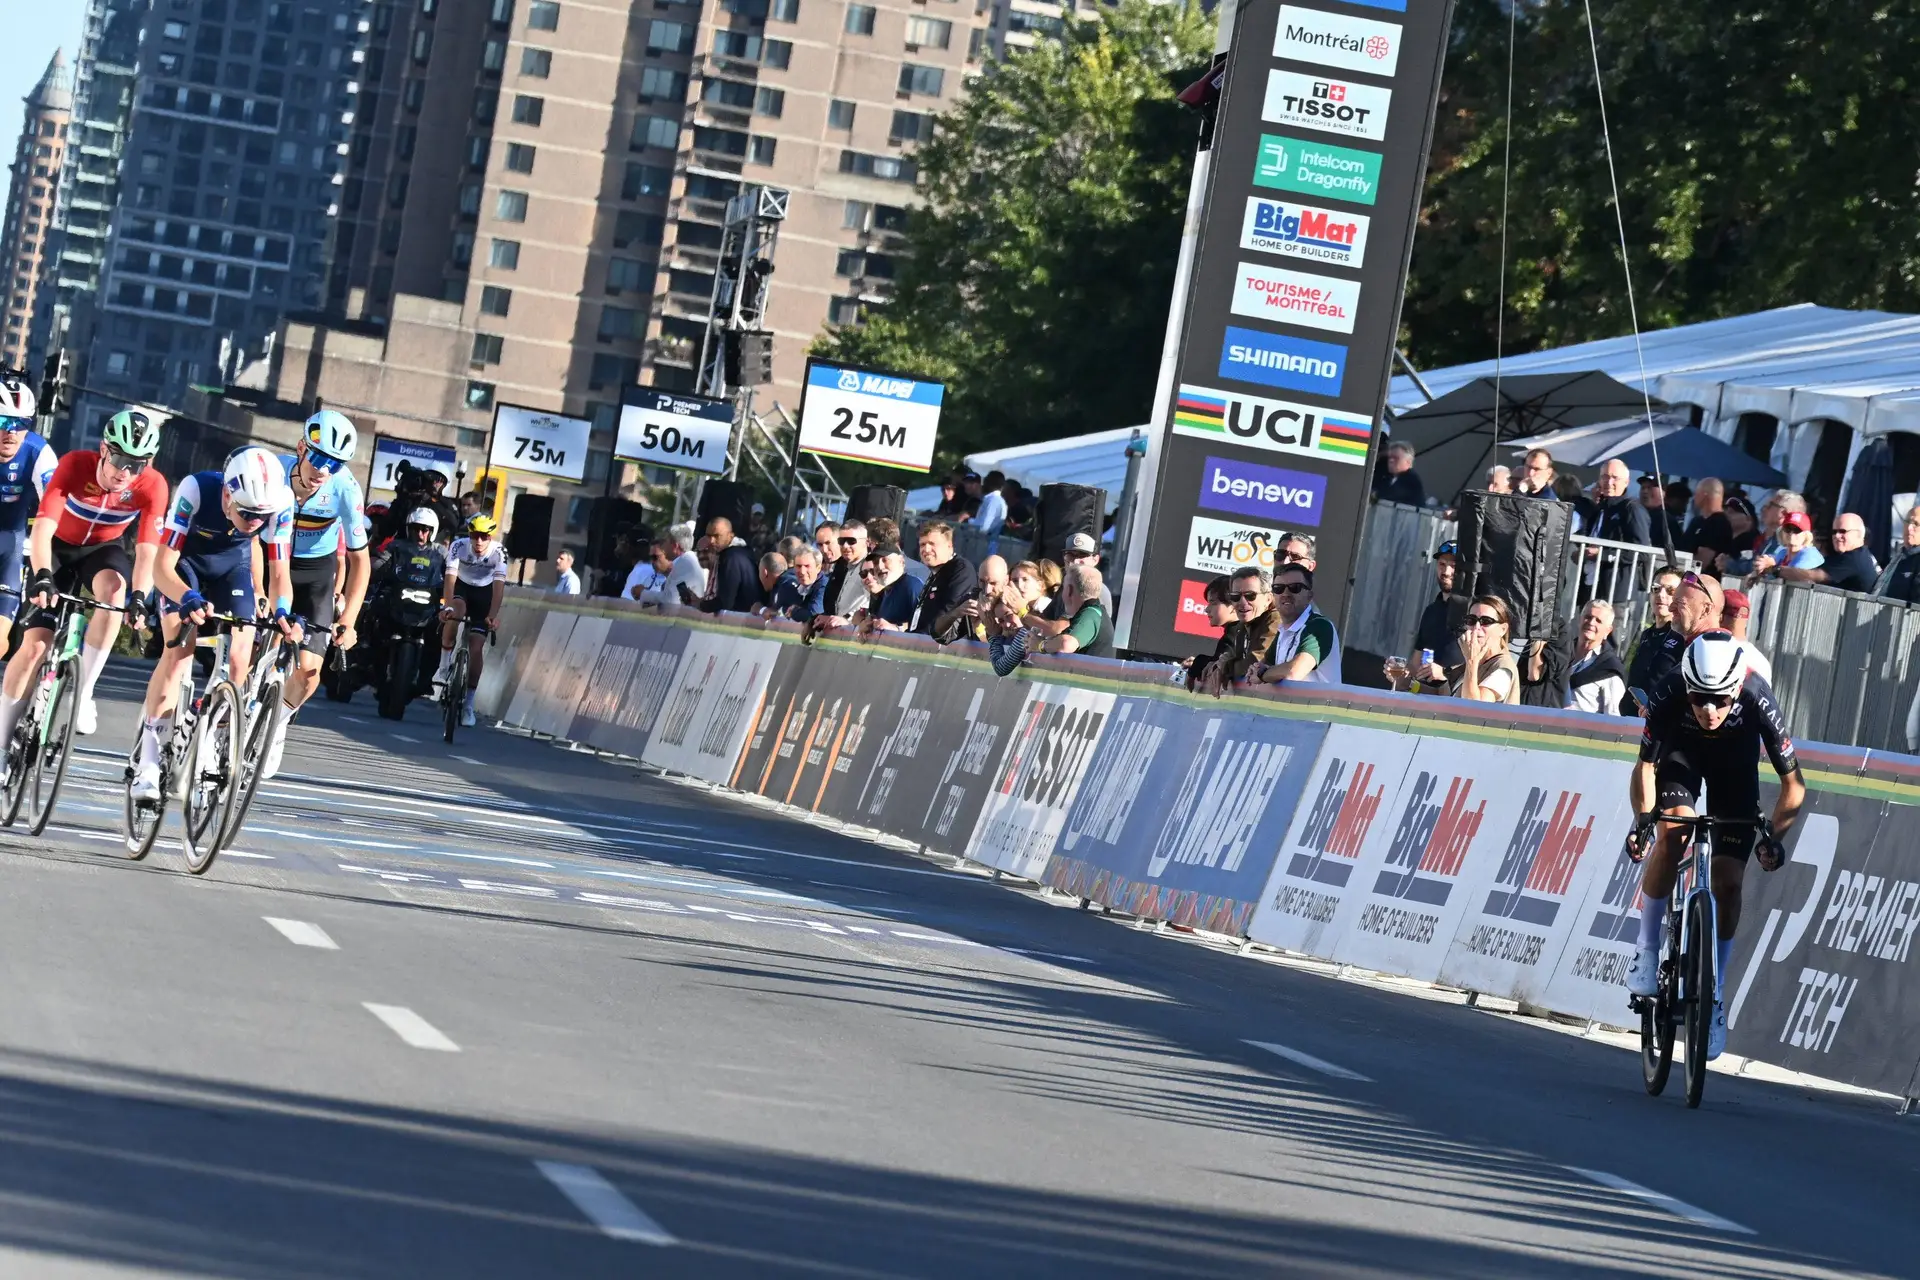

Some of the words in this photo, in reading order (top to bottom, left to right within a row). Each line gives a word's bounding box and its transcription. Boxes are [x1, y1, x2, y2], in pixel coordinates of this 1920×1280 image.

[1286, 24, 1364, 53] Montréal
[1283, 95, 1371, 124] TISSOT
[1301, 117, 1331, 127] WATCHES
[1333, 122, 1351, 131] SINCE
[1300, 149, 1365, 174] Intelcom
[1297, 166, 1372, 195] Dragonfly
[1255, 202, 1357, 243] BigMat
[1251, 237, 1282, 250] HOME
[1284, 243, 1298, 252] OF
[1301, 246, 1350, 261] BUILDERS
[1228, 345, 1337, 379] SHIMANO
[673, 400, 701, 411] PREMIER
[673, 407, 690, 415] TECH
[640, 423, 705, 458] 50M
[830, 407, 906, 448] 25M
[1228, 401, 1315, 447] UCI
[400, 445, 434, 458] beneva
[514, 436, 565, 466] 75M
[1212, 468, 1314, 508] beneva
[1197, 561, 1228, 572] VIRTUAL
[1012, 701, 1104, 809] TISSOT
[1298, 758, 1385, 879] BigMat
[1384, 771, 1487, 898] BigMat
[1494, 786, 1595, 918] BigMat
[1271, 885, 1299, 913] HOME
[1292, 889, 1310, 917] OF
[1302, 892, 1340, 924] BUILDERS
[1814, 869, 1920, 963] PREMIER
[1357, 903, 1389, 934] HOME
[1383, 908, 1401, 937] OF
[1394, 910, 1439, 945] BUILDERS
[1466, 924, 1495, 955] HOME
[1489, 928, 1508, 958] OF
[1500, 931, 1546, 966] BUILDERS
[1570, 947, 1602, 977] HOME
[1779, 967, 1858, 1053] TECH
